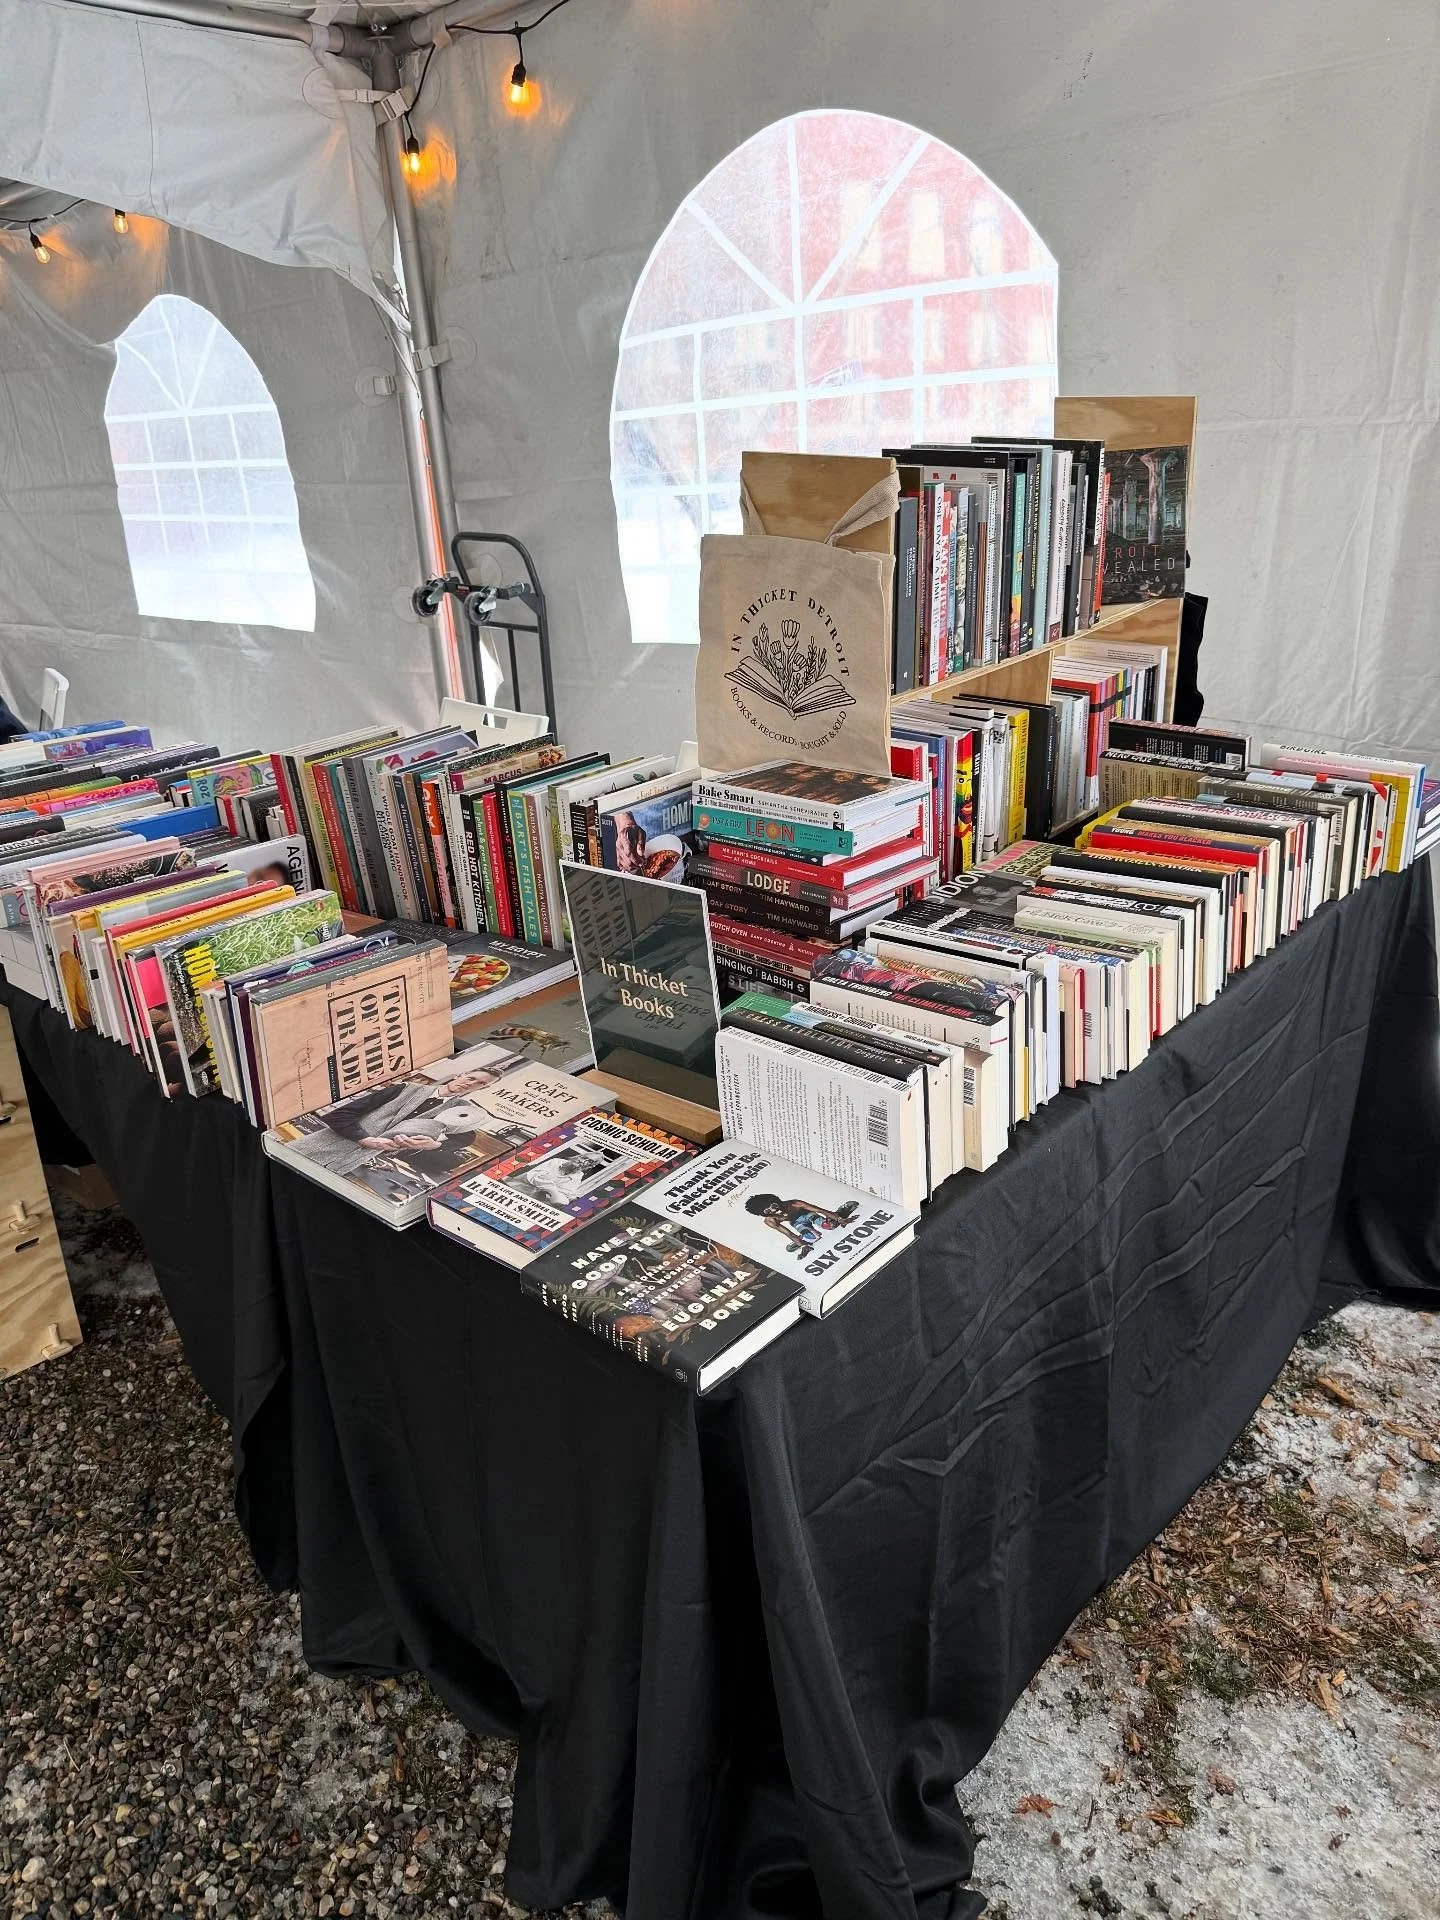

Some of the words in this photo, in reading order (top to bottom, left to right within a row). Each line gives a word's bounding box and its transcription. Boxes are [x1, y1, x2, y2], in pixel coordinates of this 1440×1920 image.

[935, 550, 940, 561] AT
[957, 539, 966, 607] MORGAN
[730, 632, 742, 654] IN
[740, 588, 798, 626] THICKET
[808, 597, 850, 677] DETROIT
[730, 687, 752, 720] BOOKS
[832, 710, 848, 733] SOLD
[1130, 754, 1152, 763] CASE
[1280, 744, 1326, 754] BIRDGIRL
[484, 768, 522, 784] MARCUS
[346, 767, 360, 803] BUTCHER
[357, 812, 367, 836] BEAST
[698, 785, 722, 800] Bake
[724, 788, 754, 804] Smart
[758, 800, 790, 810] SAMANTHA
[465, 832, 475, 854] RED
[486, 806, 495, 844] Watermelon
[515, 812, 527, 859] BART'S
[746, 818, 795, 843] LEON
[1138, 830, 1162, 838] MAKES
[1179, 835, 1212, 845] BLACKER
[381, 796, 392, 825] WHOLE
[388, 827, 397, 850] GOAT
[394, 851, 408, 900] HANDBOOK
[469, 857, 478, 878] HOT
[476, 817, 484, 837] plant
[482, 864, 492, 893] together
[750, 852, 778, 865] COCKTAILS
[286, 846, 306, 896] AGEN
[522, 864, 532, 894] FISH
[537, 873, 545, 900] NADIYA
[746, 870, 791, 894] LODGE
[472, 880, 485, 925] KITCHEN
[540, 901, 549, 933] HUSSAIN
[710, 899, 724, 908] OAF
[724, 903, 748, 914] STORY
[766, 912, 780, 922] TIM
[781, 916, 819, 932] HAYWARD
[720, 884, 743, 894] STORY
[760, 893, 774, 903] TIM
[774, 896, 810, 912] HAYWARD
[526, 900, 538, 937] TALES
[710, 922, 731, 932] DUTCH
[732, 926, 748, 937] OVEN
[488, 940, 507, 950] MY
[509, 945, 546, 958] EGYPT
[600, 957, 618, 978] In
[620, 962, 690, 998] Thicket
[716, 956, 753, 975] BINGING
[761, 971, 794, 990] BABISH
[360, 994, 380, 1024] OF
[620, 988, 675, 1020] Books
[821, 976, 848, 986] GRETA
[848, 980, 892, 997] THUNBERG
[892, 992, 906, 1001] THE
[907, 996, 949, 1012] CLIMATE
[950, 1006, 975, 1018] BOOK
[336, 1000, 364, 1090] TRADE
[382, 984, 406, 1072] TOOLS
[751, 1012, 781, 1028] CHESS
[782, 1022, 853, 1051] REVOLUTION
[855, 1048, 886, 1062] Doggers
[363, 1026, 384, 1081] THE
[728, 1026, 750, 1042] GREIL
[753, 1034, 785, 1052] MARCUS
[799, 1050, 838, 1067] MYSTERY
[840, 1060, 868, 1076] TRAIN
[492, 1088, 560, 1118] MAKERS
[523, 1091, 538, 1100] and
[538, 1096, 551, 1104] the
[524, 1080, 578, 1103] CRAFT
[580, 1116, 622, 1140] COSMIC
[622, 1130, 678, 1160] SCHOLAR
[664, 1168, 712, 1199] Thank
[710, 1152, 738, 1172] You
[666, 1161, 744, 1214] (Falettinme
[741, 1150, 762, 1168] Be
[682, 1191, 721, 1218] Mice
[719, 1179, 739, 1198] Elf
[734, 1160, 772, 1187] Agin)
[466, 1180, 514, 1206] HARRY
[512, 1202, 562, 1229] SMITH
[475, 1200, 494, 1213] JOHN
[494, 1209, 523, 1224] SZWED
[487, 1179, 499, 1188] THE
[500, 1184, 514, 1194] LIFE
[514, 1192, 529, 1202] AND
[528, 1199, 549, 1212] TIMES
[549, 1209, 560, 1218] OF
[571, 1236, 626, 1270] HAVE
[626, 1226, 642, 1236] A
[571, 1254, 628, 1290] GOOD
[628, 1223, 674, 1252] TRIP
[804, 1249, 841, 1278] SLY
[832, 1209, 896, 1255] STONE
[617, 1260, 671, 1296] EXPLORING
[670, 1247, 690, 1260] THE
[622, 1284, 656, 1308] MAGIC
[658, 1249, 708, 1285] MUSHROOM
[650, 1264, 706, 1304] EXPERIENCE
[661, 1270, 752, 1332] EUGENIA
[698, 1290, 756, 1331] BONE
